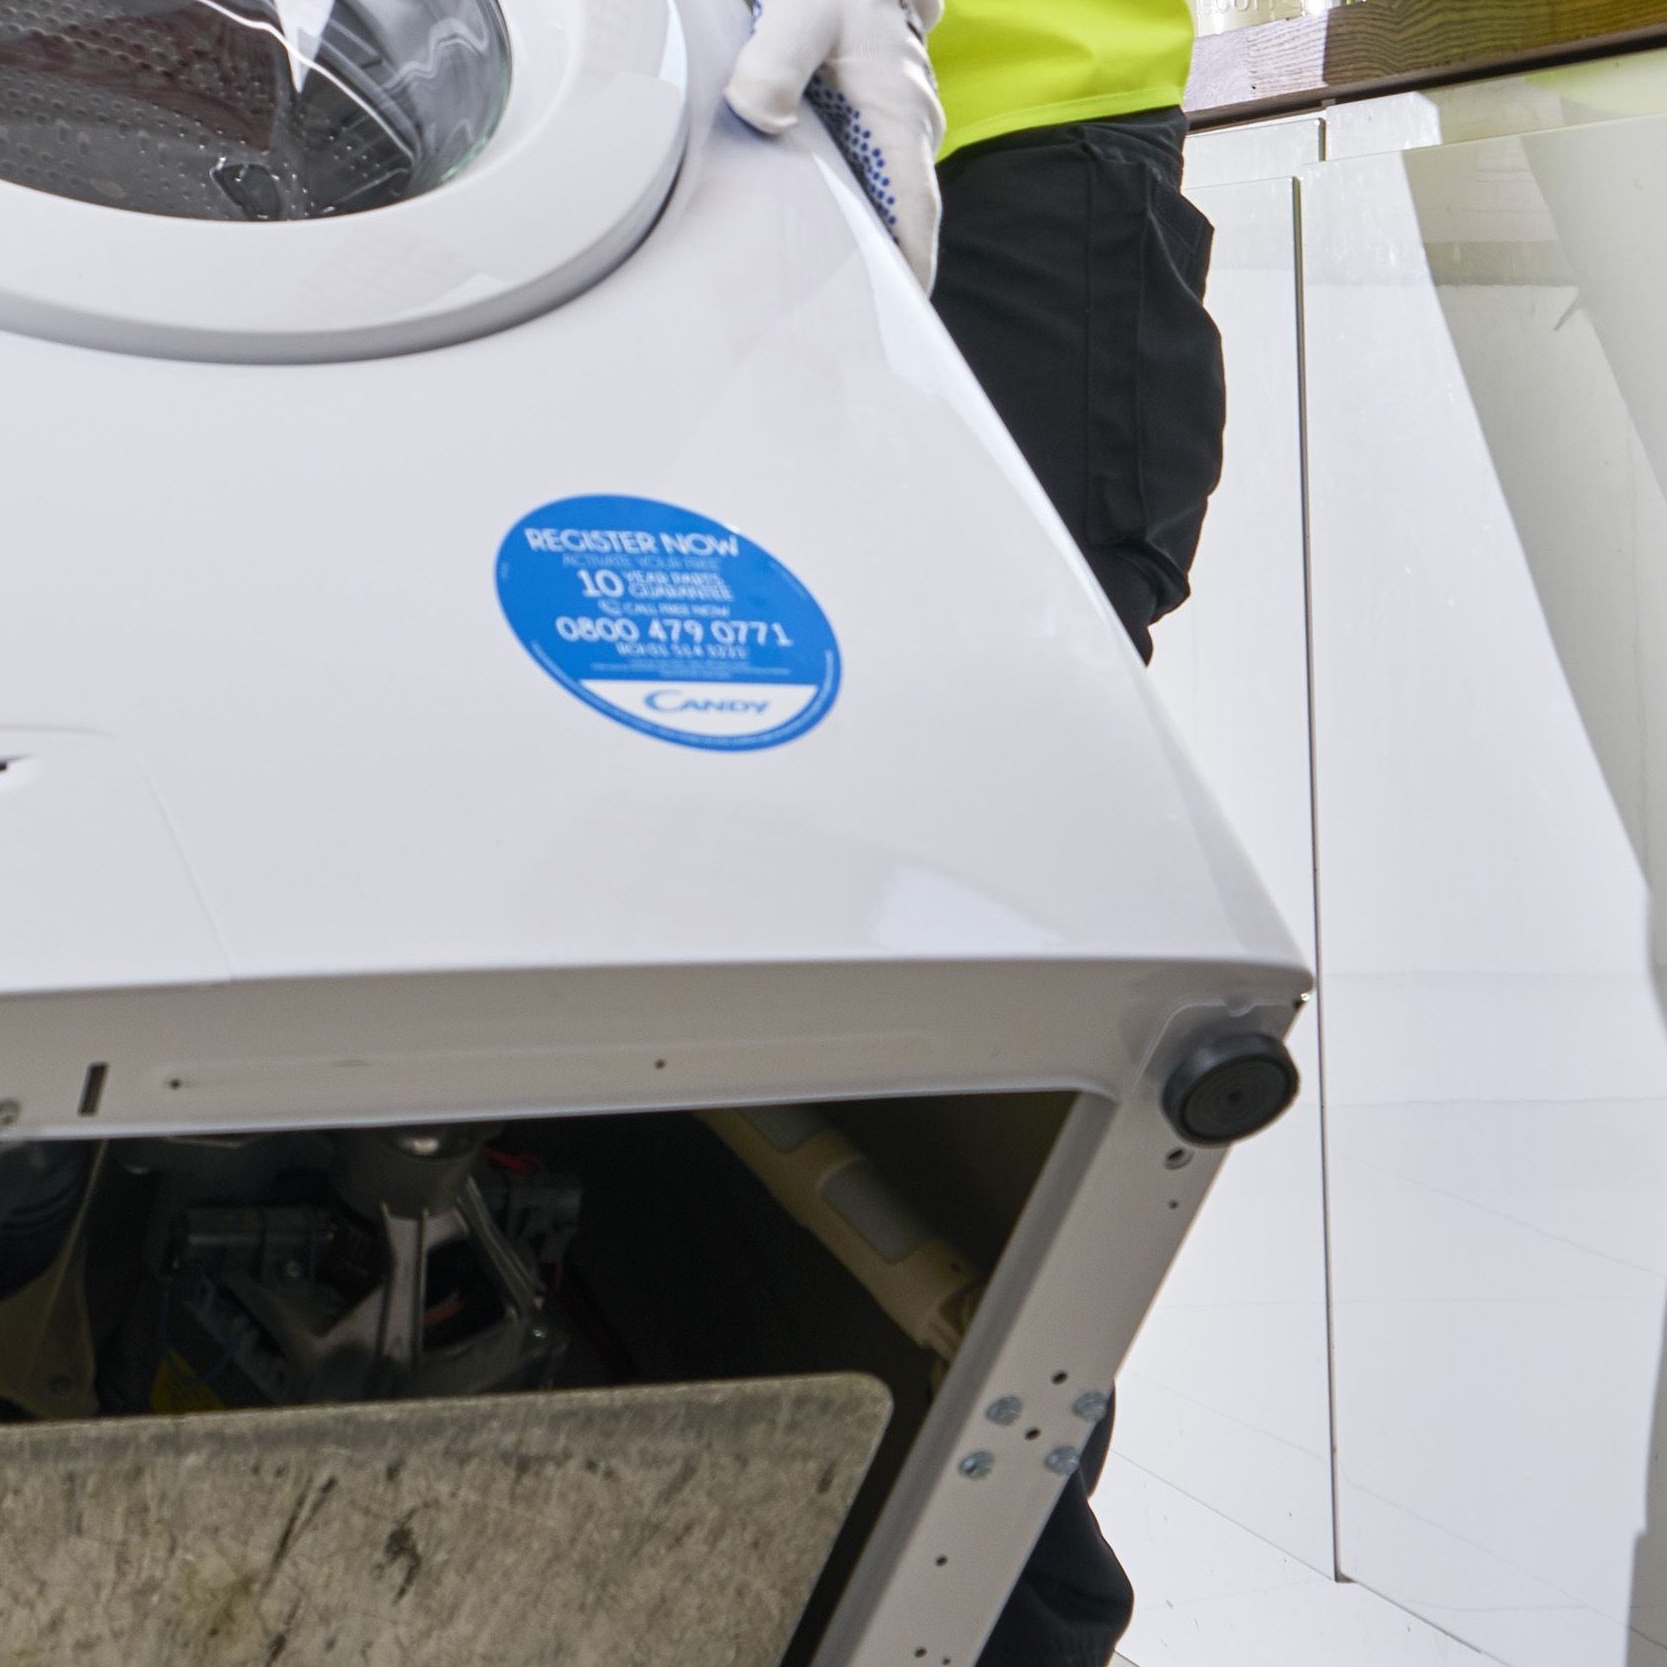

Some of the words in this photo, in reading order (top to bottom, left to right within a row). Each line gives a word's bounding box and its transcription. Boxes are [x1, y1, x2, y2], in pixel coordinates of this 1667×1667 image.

[525, 529, 656, 553] REGISTER
[660, 533, 739, 557] NOW
[577, 570, 625, 598] 10
[621, 570, 670, 584] YEAR
[628, 583, 734, 602] GUARANTEE
[555, 616, 640, 643] 0800
[647, 618, 705, 645] 479
[710, 620, 794, 648] 0771
